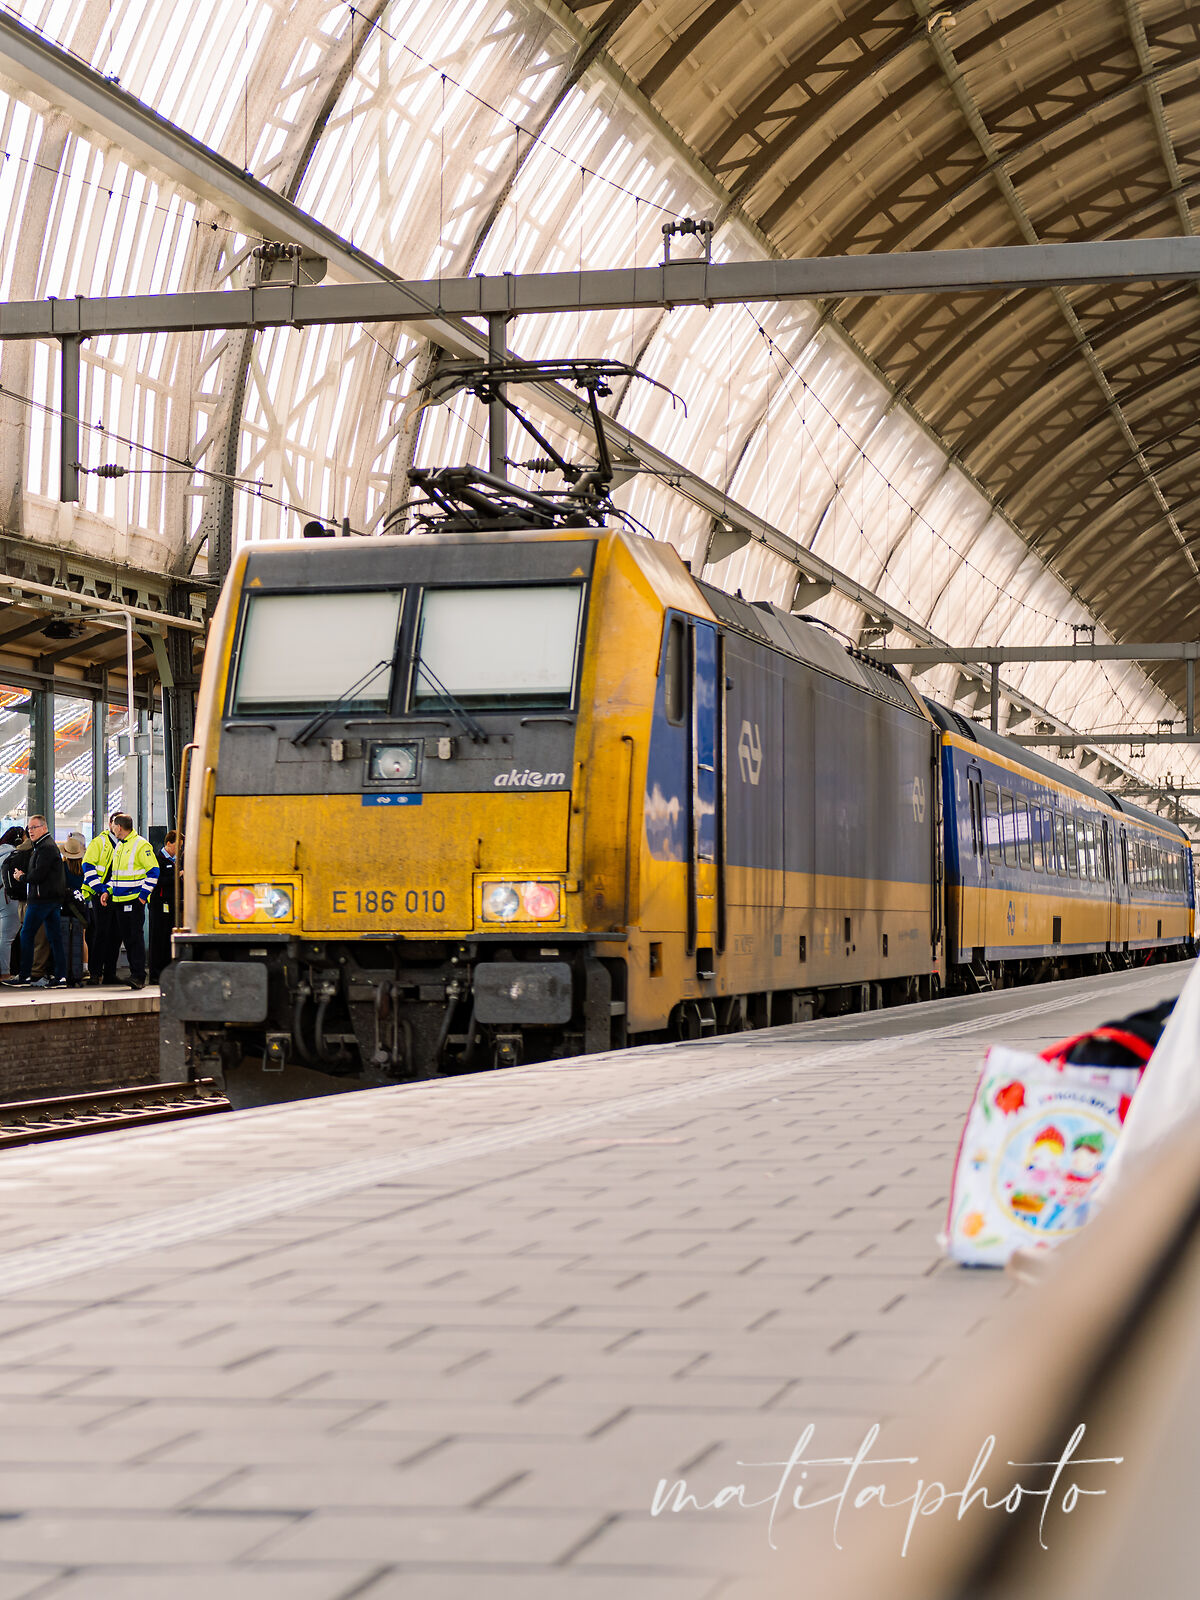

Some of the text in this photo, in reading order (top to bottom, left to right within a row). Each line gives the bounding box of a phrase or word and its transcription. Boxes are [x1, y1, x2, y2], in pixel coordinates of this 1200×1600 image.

[494, 769, 565, 787] akiem
[333, 890, 445, 913] E 186 010
